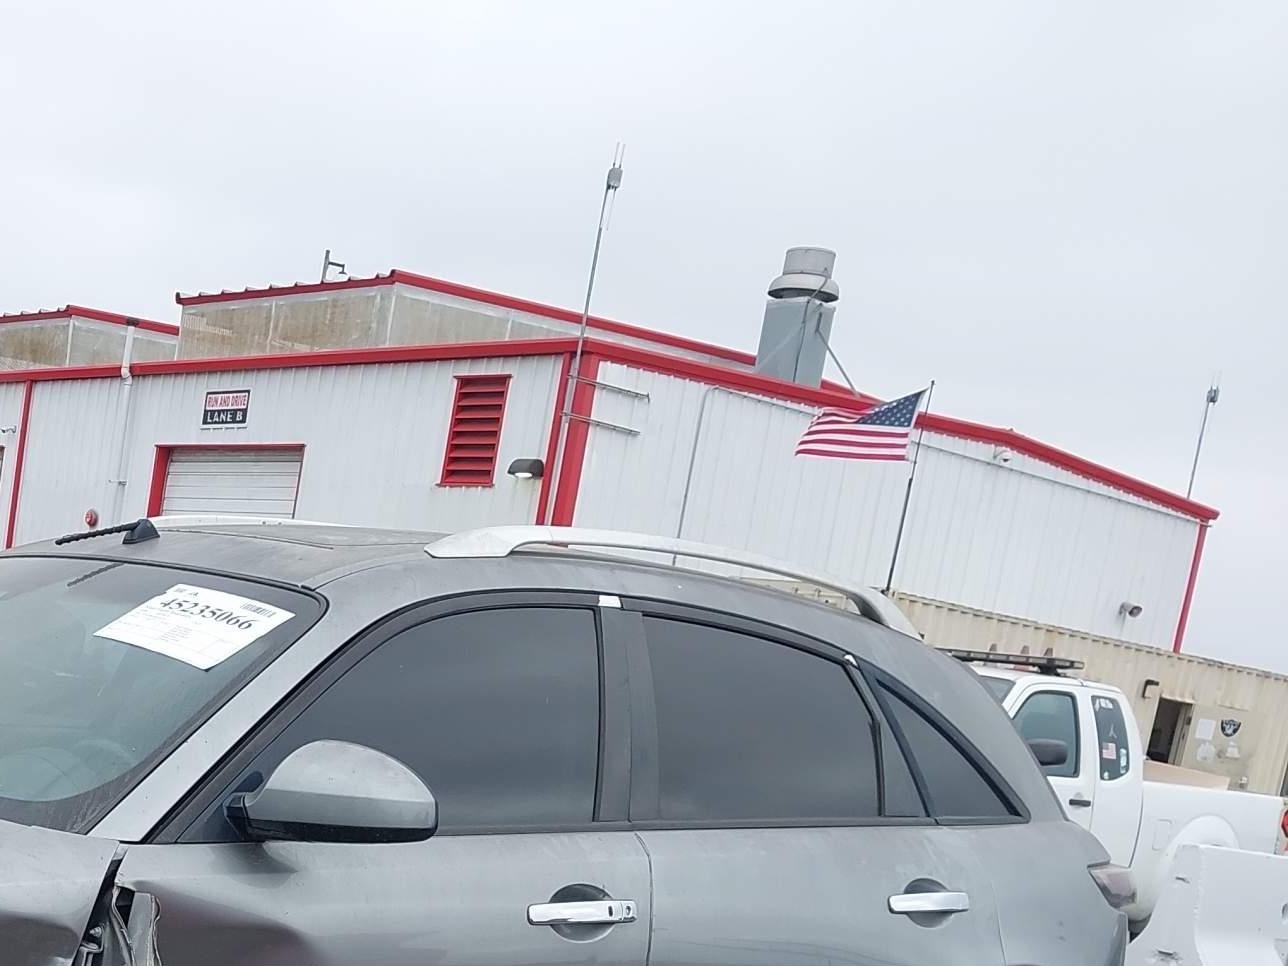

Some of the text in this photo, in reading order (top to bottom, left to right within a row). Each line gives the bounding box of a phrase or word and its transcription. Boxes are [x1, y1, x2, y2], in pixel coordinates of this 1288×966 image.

[207, 394, 247, 408] RUN AND DRIVE
[207, 410, 243, 422] LANE B
[160, 599, 260, 630] 45235066
